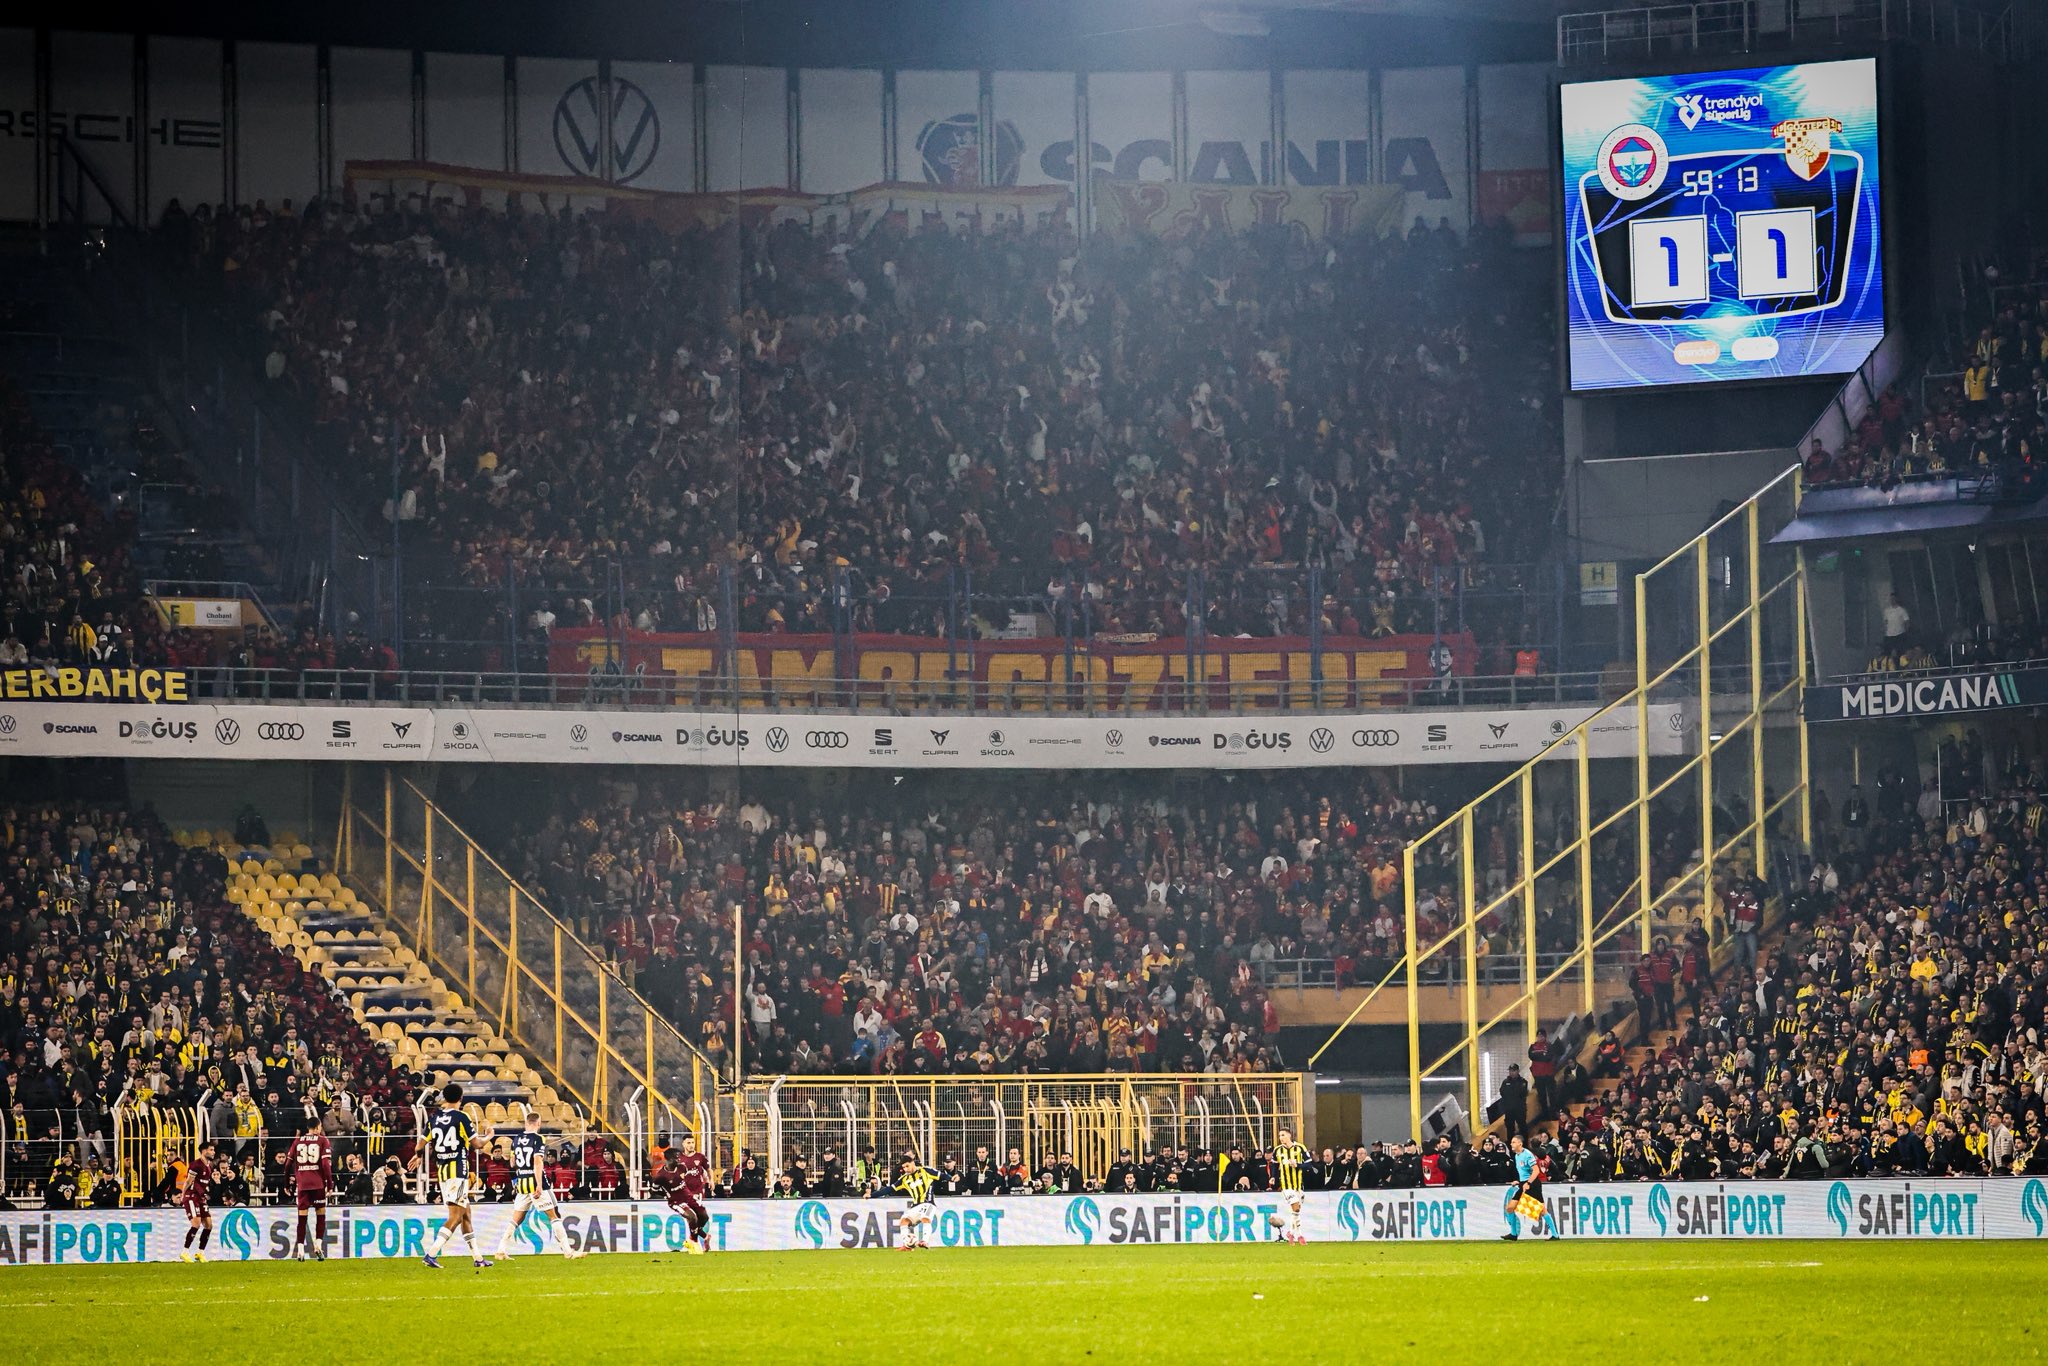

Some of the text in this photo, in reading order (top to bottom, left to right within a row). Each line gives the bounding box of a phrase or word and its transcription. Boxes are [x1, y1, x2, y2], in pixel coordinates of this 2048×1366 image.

[1704, 93, 1763, 110] trendyol
[1039, 136, 1453, 201] SCANIA
[1659, 236, 1679, 288] 1
[1767, 228, 1787, 280] 1
[1592, 566, 1604, 581] H
[0, 667, 188, 705] ERBAHÇE
[1842, 675, 2004, 717] MEDICANA
[55, 725, 98, 734] SCANIA
[623, 734, 663, 742] SCANIA
[1160, 737, 1201, 745] SCANIA
[296, 1143, 320, 1164] 39
[431, 1125, 461, 1153] 24
[562, 1204, 733, 1254] SAFİPOT
[839, 1201, 1005, 1248] SAFORT
[1371, 1191, 1467, 1240] SAFİPORT
[1676, 1184, 1786, 1236] SAFİPORT
[1858, 1182, 1979, 1236] SAFİPORT
